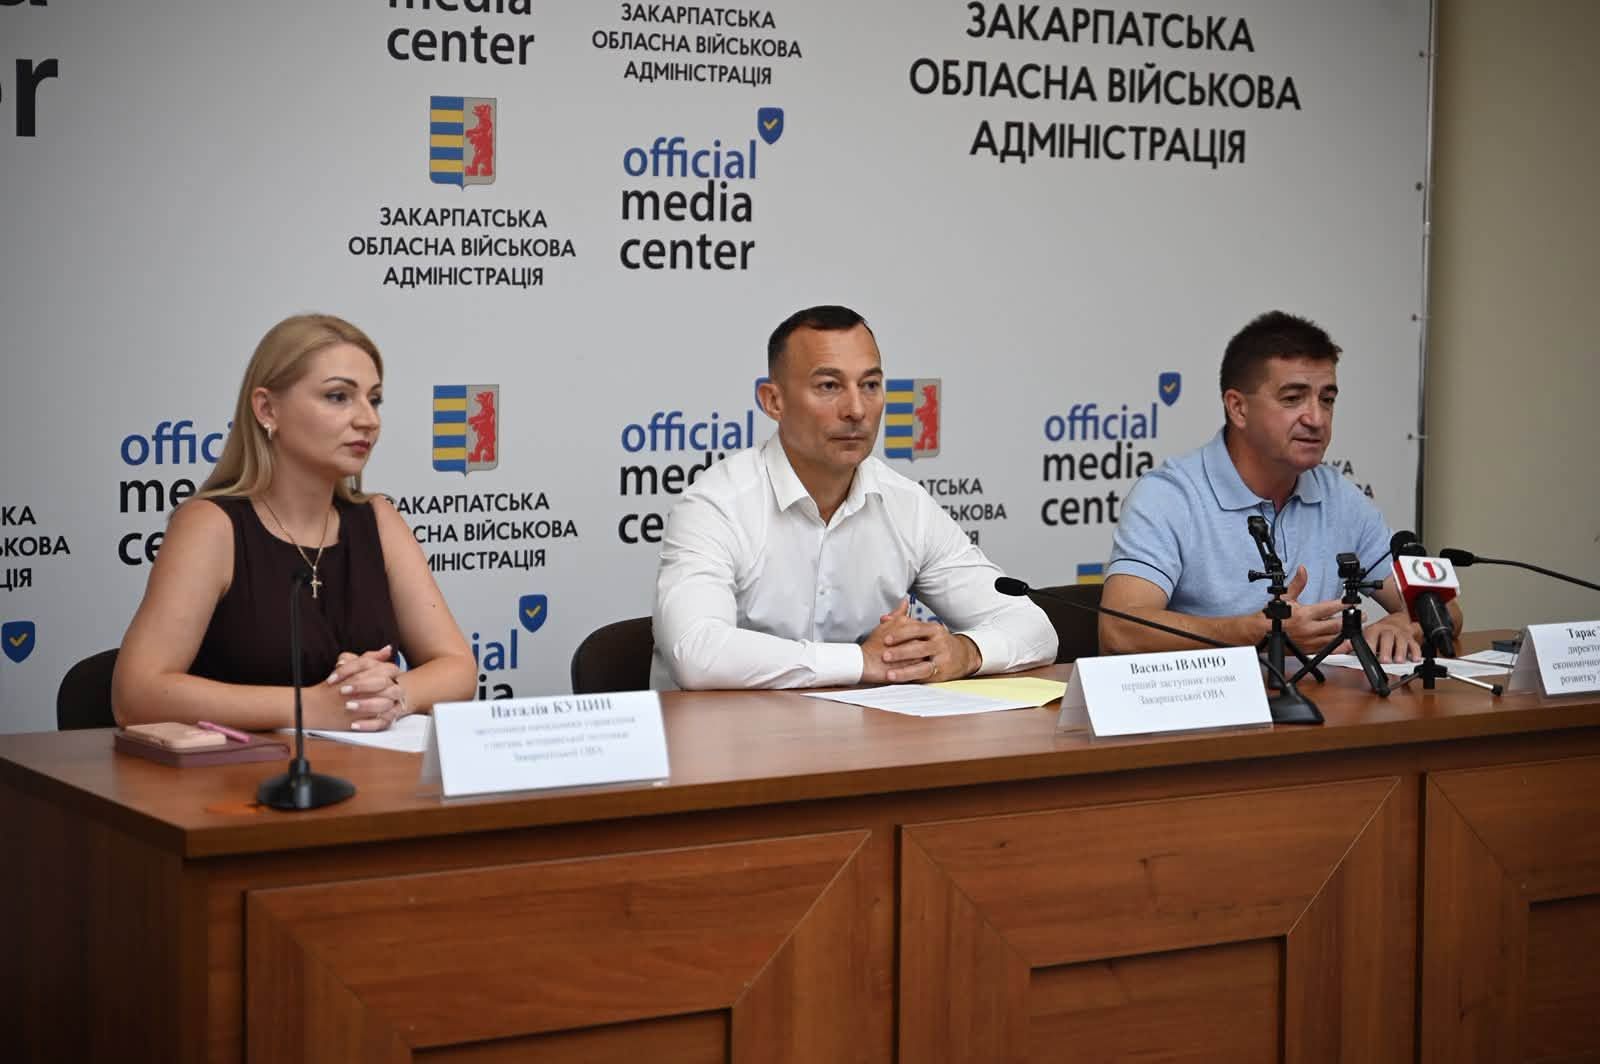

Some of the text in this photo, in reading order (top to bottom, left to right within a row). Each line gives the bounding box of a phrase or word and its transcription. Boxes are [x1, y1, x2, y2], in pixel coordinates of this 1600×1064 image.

[621, 3, 776, 29] ЗАКАРПАТСЬКА
[966, 1, 1255, 52] ЗАКАРПАТСЬКА
[387, 25, 535, 65] center
[592, 30, 803, 58] ОБЛАСНА ВІЙСЬКОВА
[623, 60, 772, 87] АДМІНІСТРАЦІЯ
[909, 58, 1301, 110] ОБЛАСНА ВІЙСЬКОВА
[623, 136, 757, 180] official
[970, 120, 1246, 170] АДМІНІСТРАЦІЯ
[380, 207, 548, 228] ЗАКАРПАТСЬКА
[621, 179, 752, 222] media
[348, 234, 577, 257] ОБЛАСНА ВІЙСЬКОВА
[620, 233, 755, 270] center
[383, 266, 544, 289] АДМІНІСТРАЦІЯ
[621, 410, 754, 453] official
[1044, 402, 1158, 442] official
[121, 420, 233, 466] offic
[1043, 441, 1154, 482] media
[620, 451, 725, 496] med
[1041, 490, 1120, 526] cent
[464, 519, 578, 542] ВІЙСЬКОВА
[1130, 655, 1227, 675] Василь ІВАНЧО
